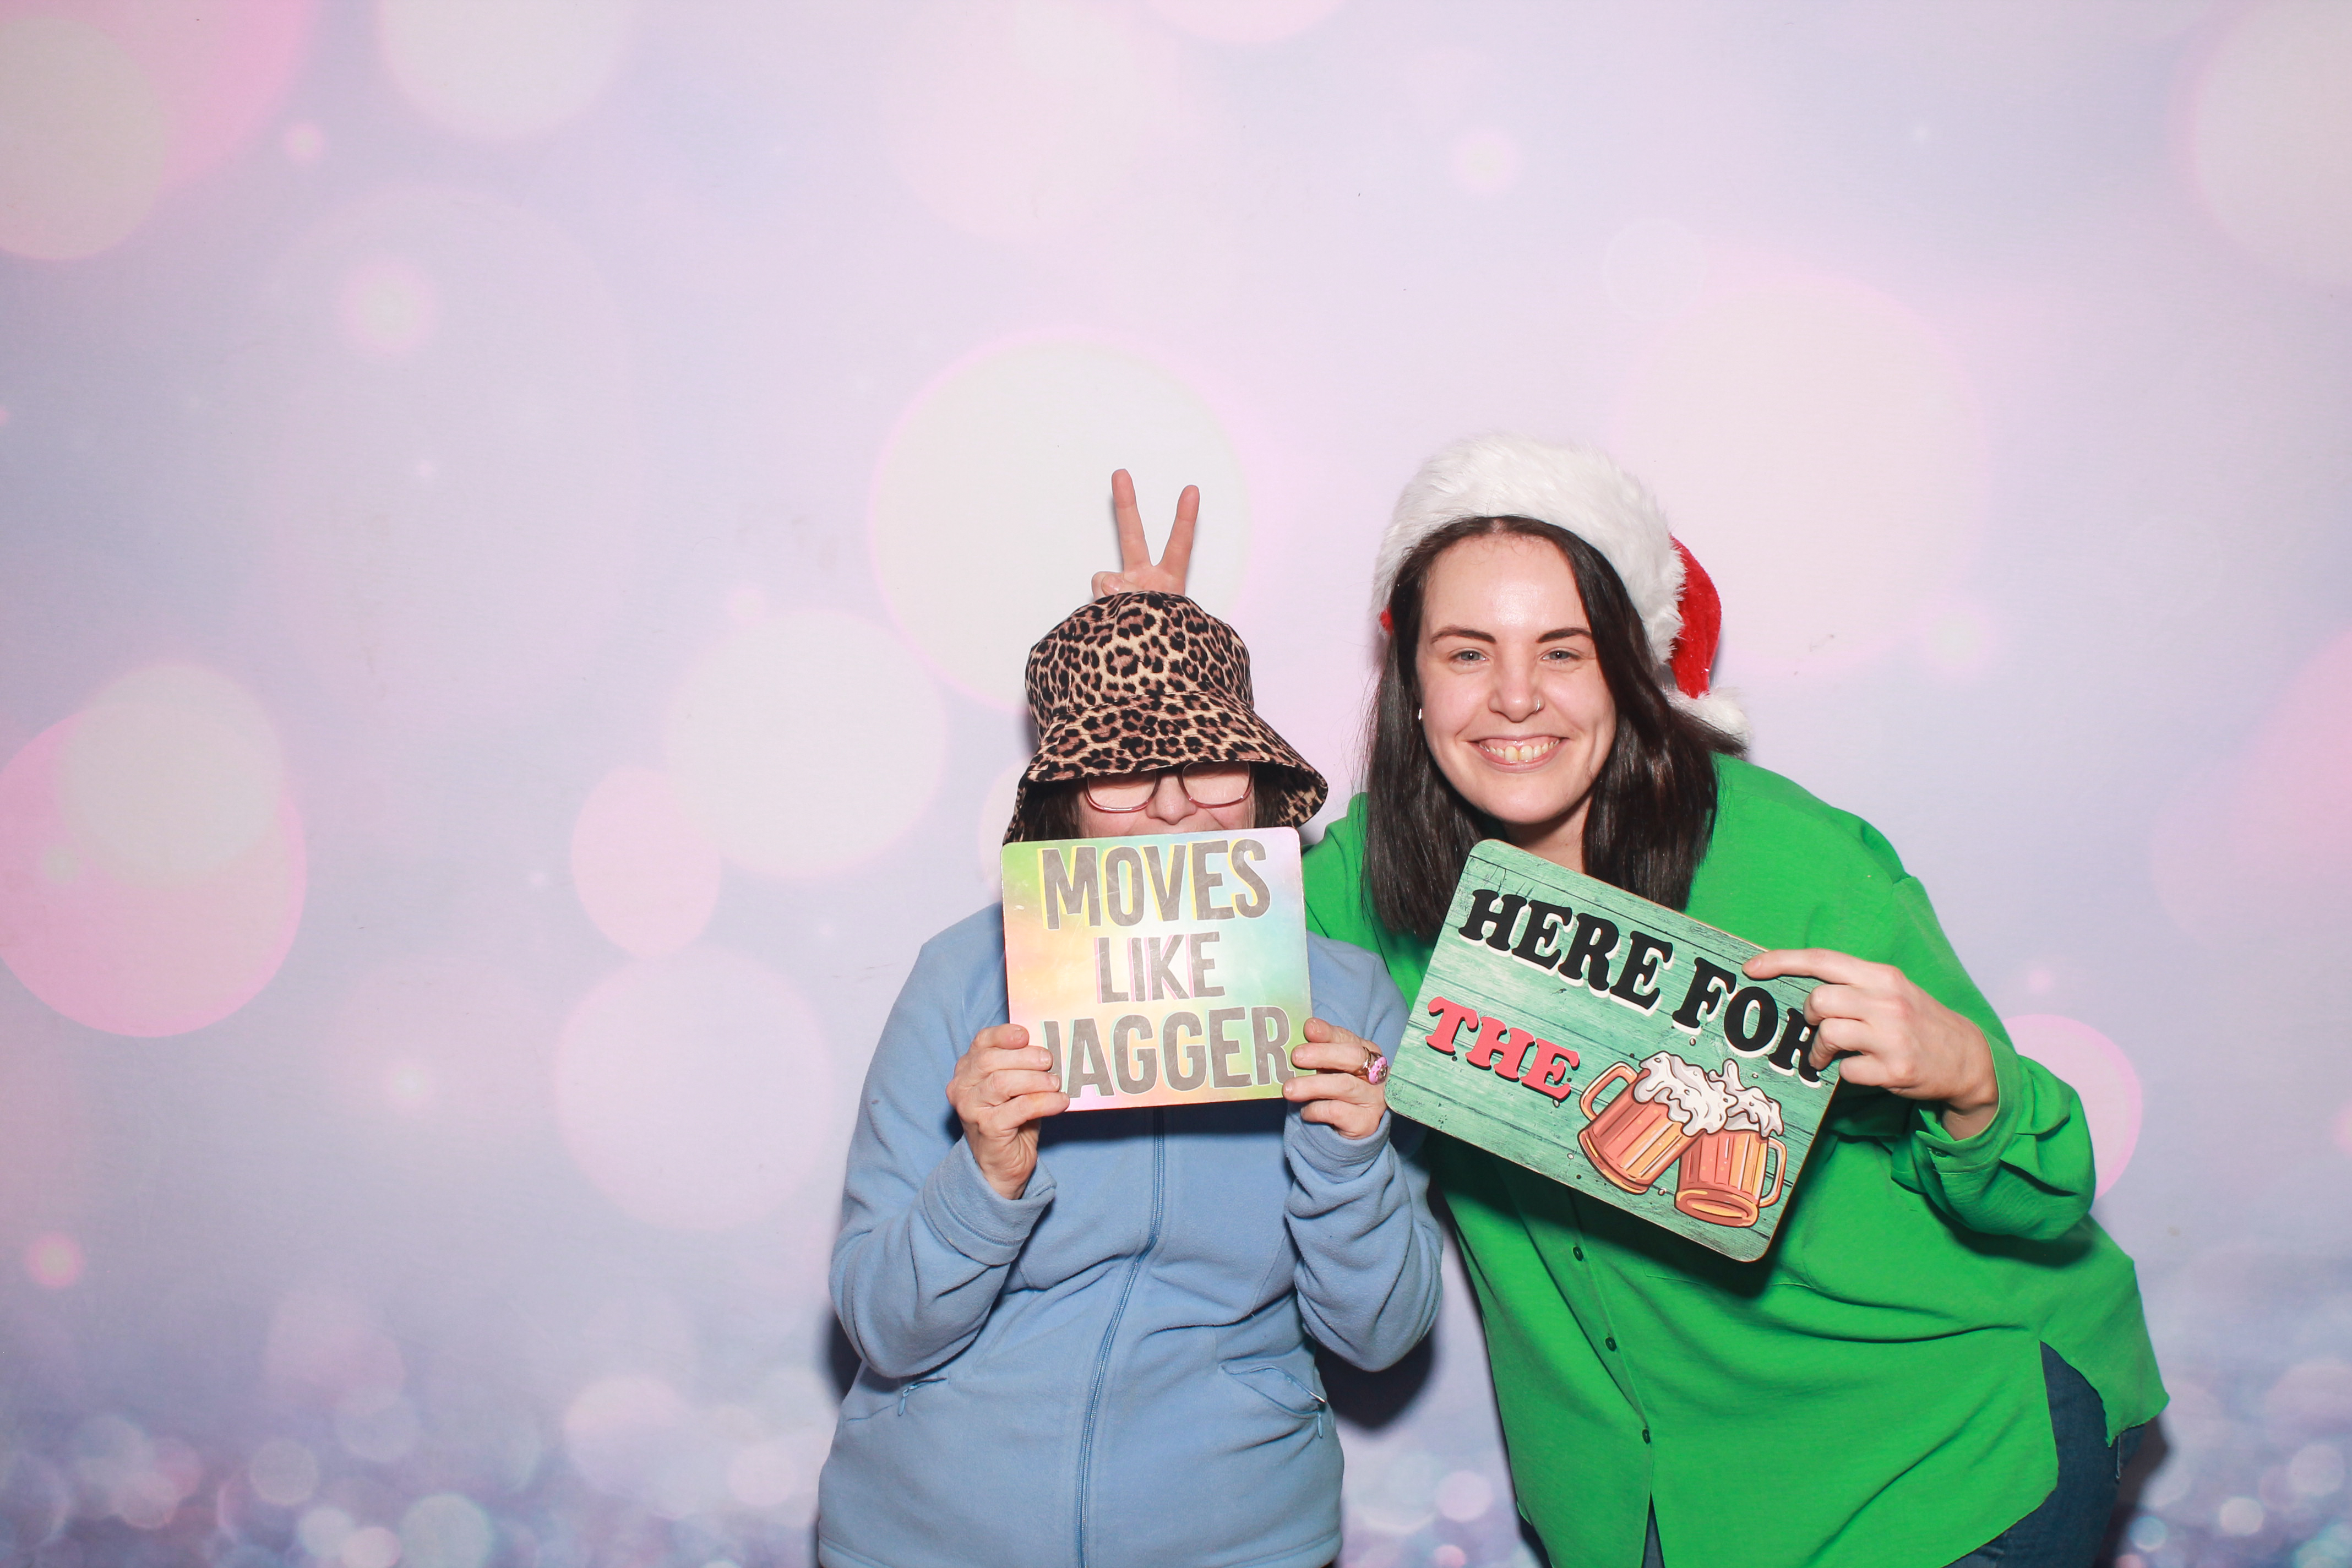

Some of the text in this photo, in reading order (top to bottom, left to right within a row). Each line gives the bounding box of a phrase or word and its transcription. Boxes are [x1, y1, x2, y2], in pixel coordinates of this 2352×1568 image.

[1037, 838, 1271, 929] MOVES
[1094, 931, 1226, 1004] LIKE
[1458, 889, 1822, 1088] HERE FOR
[1425, 997, 1581, 1102] THE
